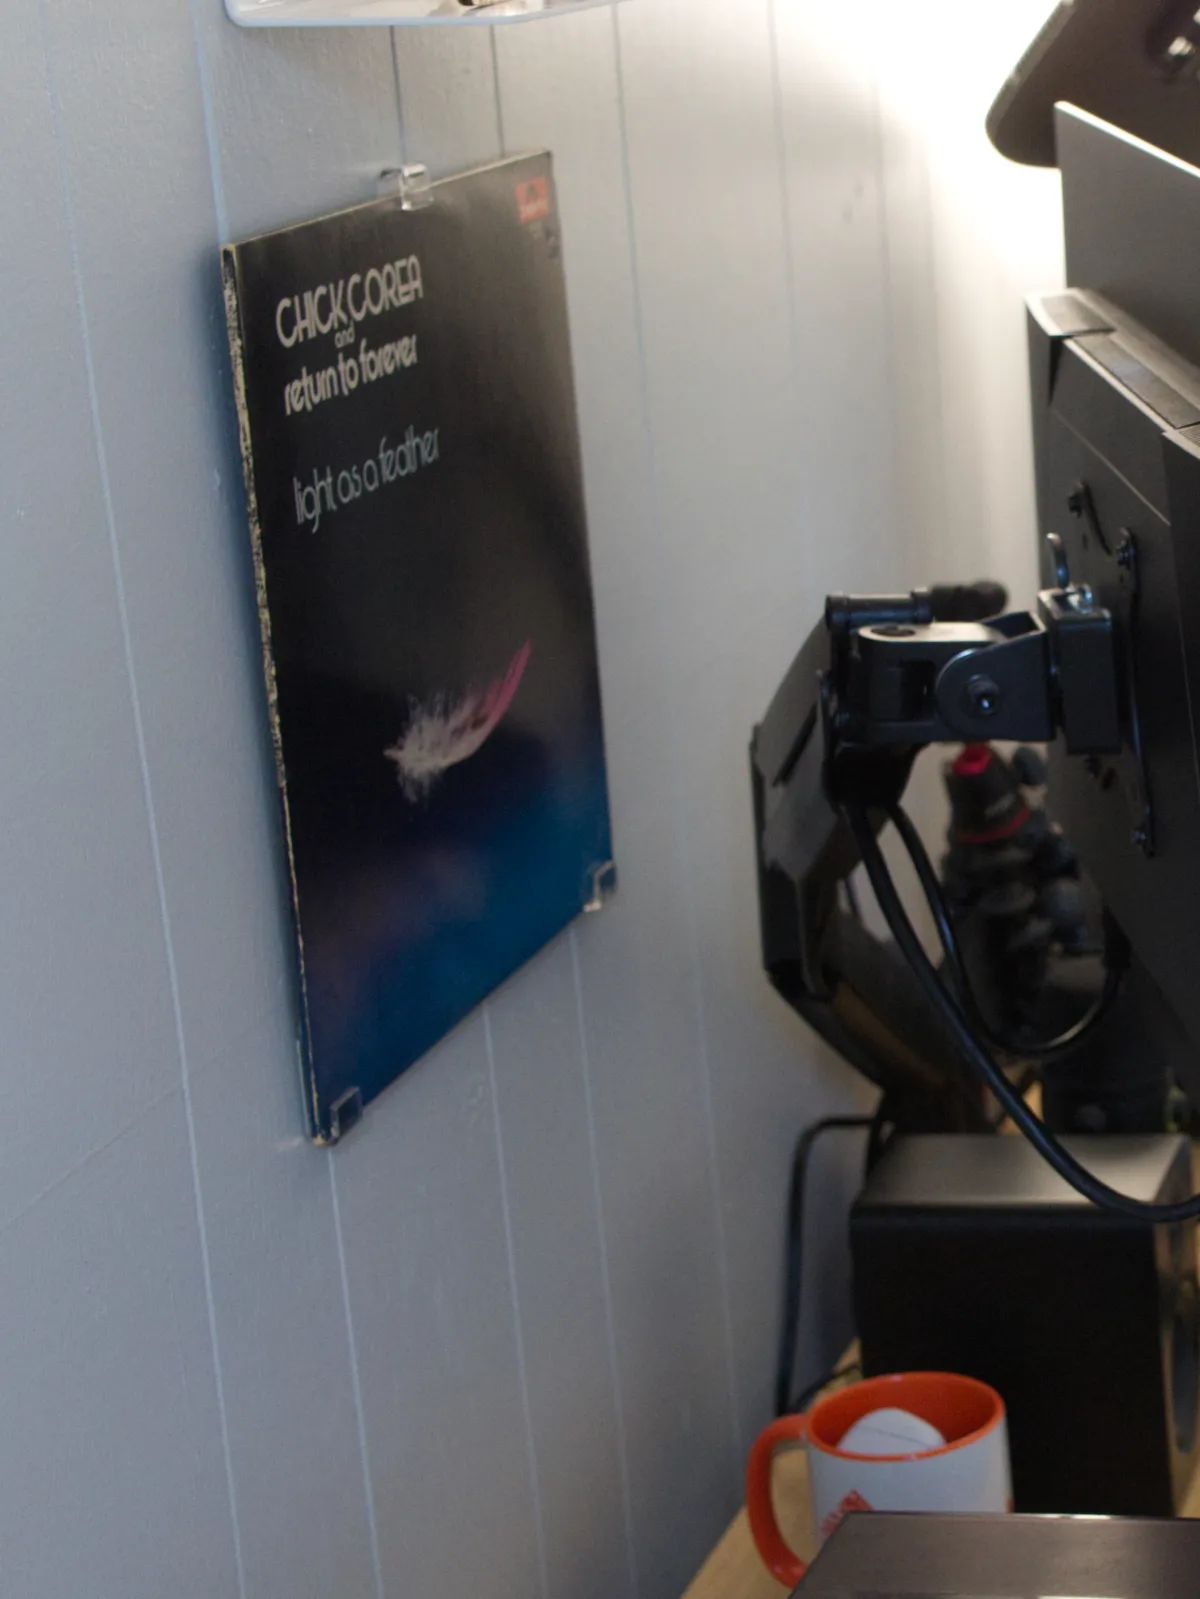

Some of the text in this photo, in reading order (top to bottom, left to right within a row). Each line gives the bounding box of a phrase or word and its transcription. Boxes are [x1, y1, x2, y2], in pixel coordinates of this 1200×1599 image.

[275, 254, 424, 348] CHICK COREA
[334, 319, 356, 349] and
[284, 334, 418, 416] return to forever
[293, 424, 439, 534] light as a feather
